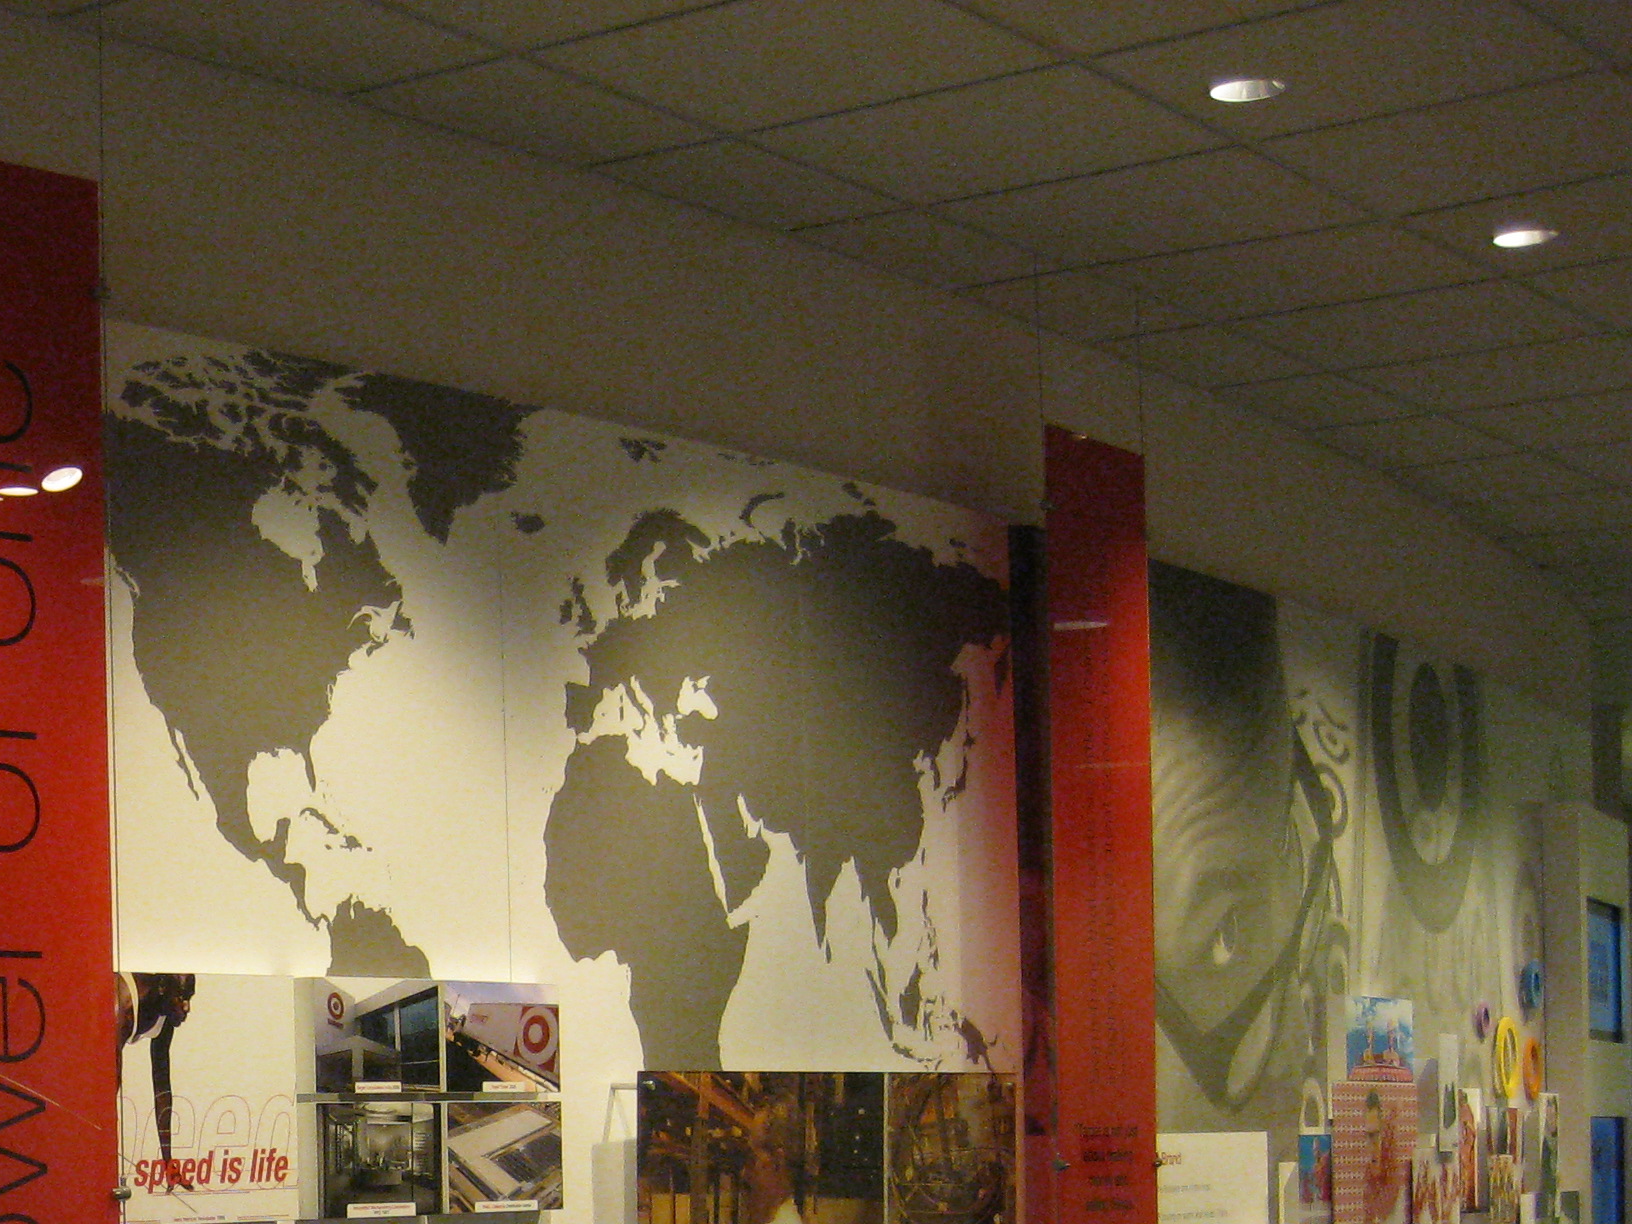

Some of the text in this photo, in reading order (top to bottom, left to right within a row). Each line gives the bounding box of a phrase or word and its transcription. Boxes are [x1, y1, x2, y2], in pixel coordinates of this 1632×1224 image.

[134, 1148, 288, 1194] speed is life
